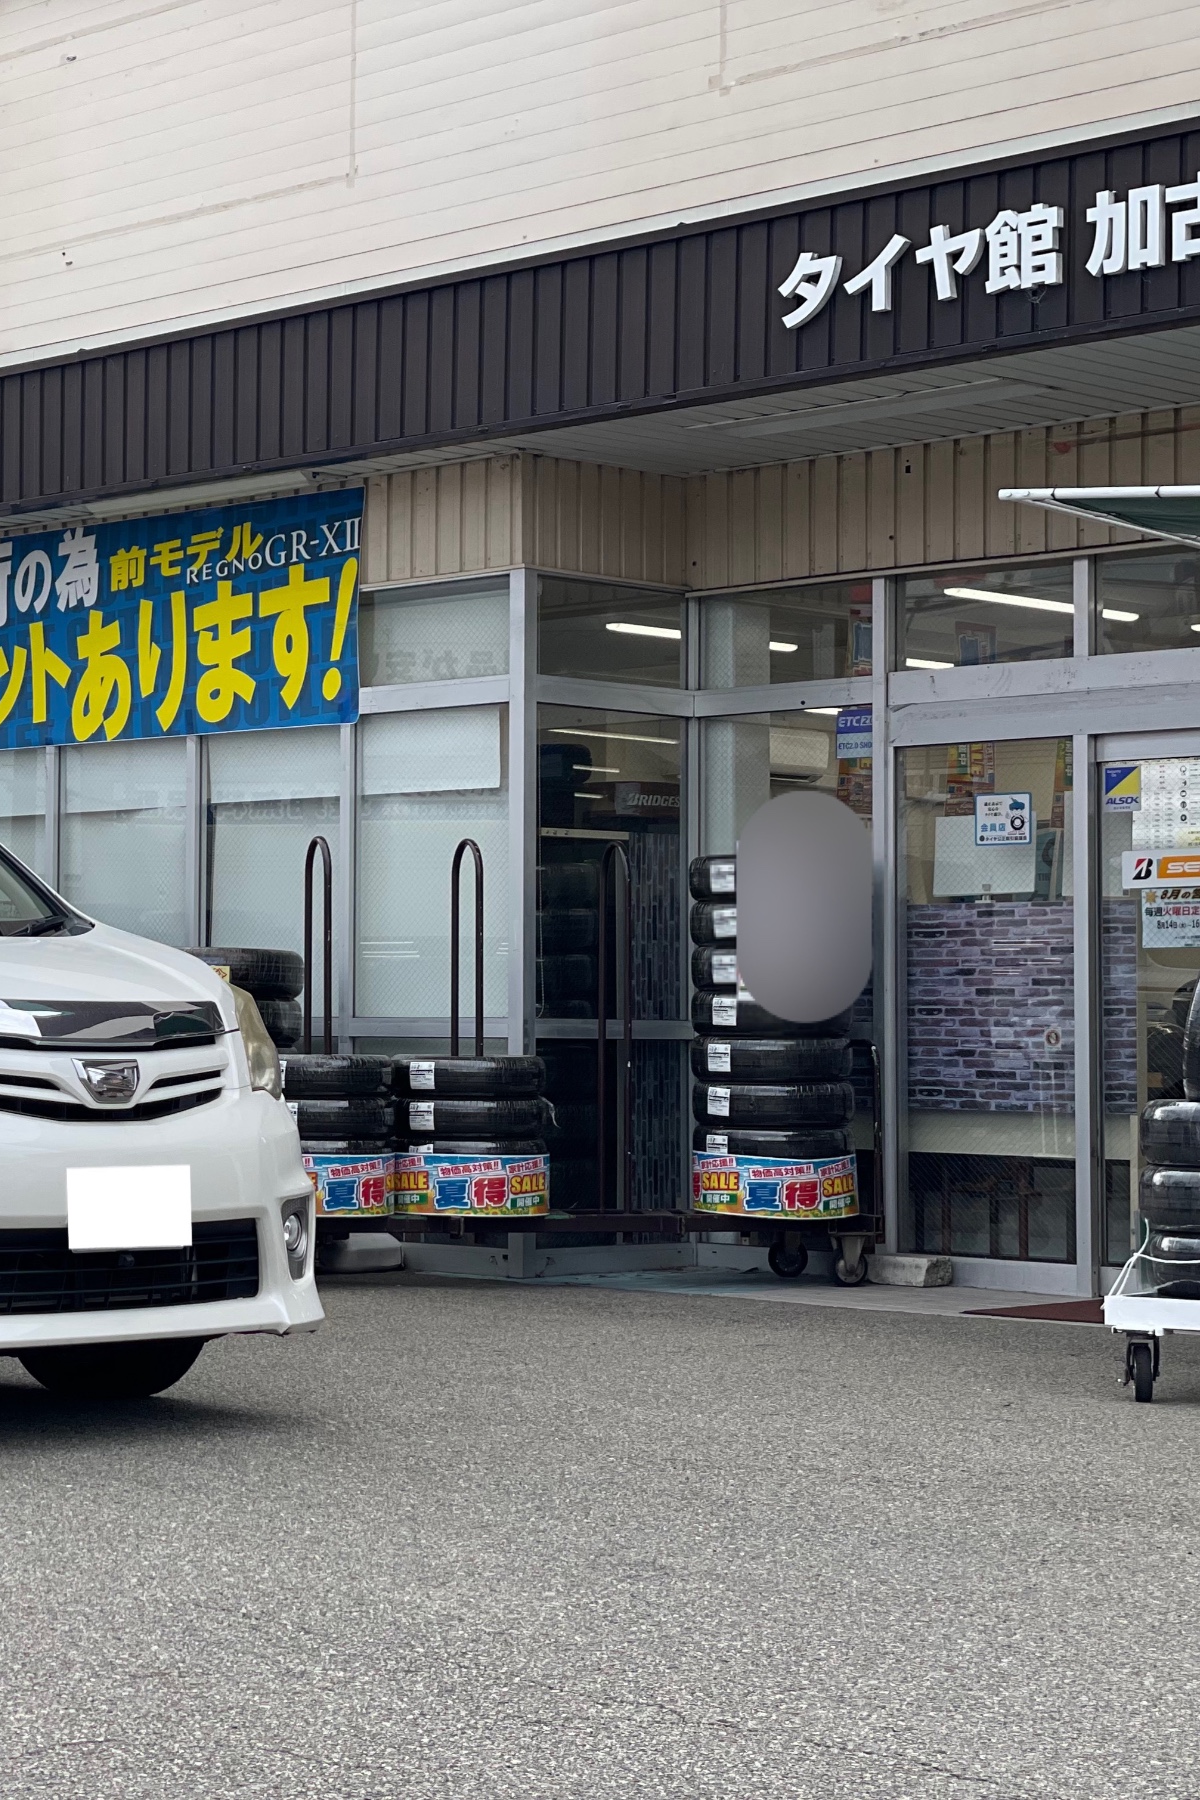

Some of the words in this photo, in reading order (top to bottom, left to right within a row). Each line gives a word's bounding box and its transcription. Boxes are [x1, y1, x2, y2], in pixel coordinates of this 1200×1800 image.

[777, 202, 1064, 329] タイヤ館
[109, 522, 264, 592] 前モデル
[1106, 796, 1139, 805] ALSOK
[435, 1176, 508, 1210] 夏得
[510, 1172, 546, 1195] SALE
[702, 1172, 739, 1191] SALE
[822, 1173, 854, 1197] SALE
[745, 1180, 820, 1211] 夏得
